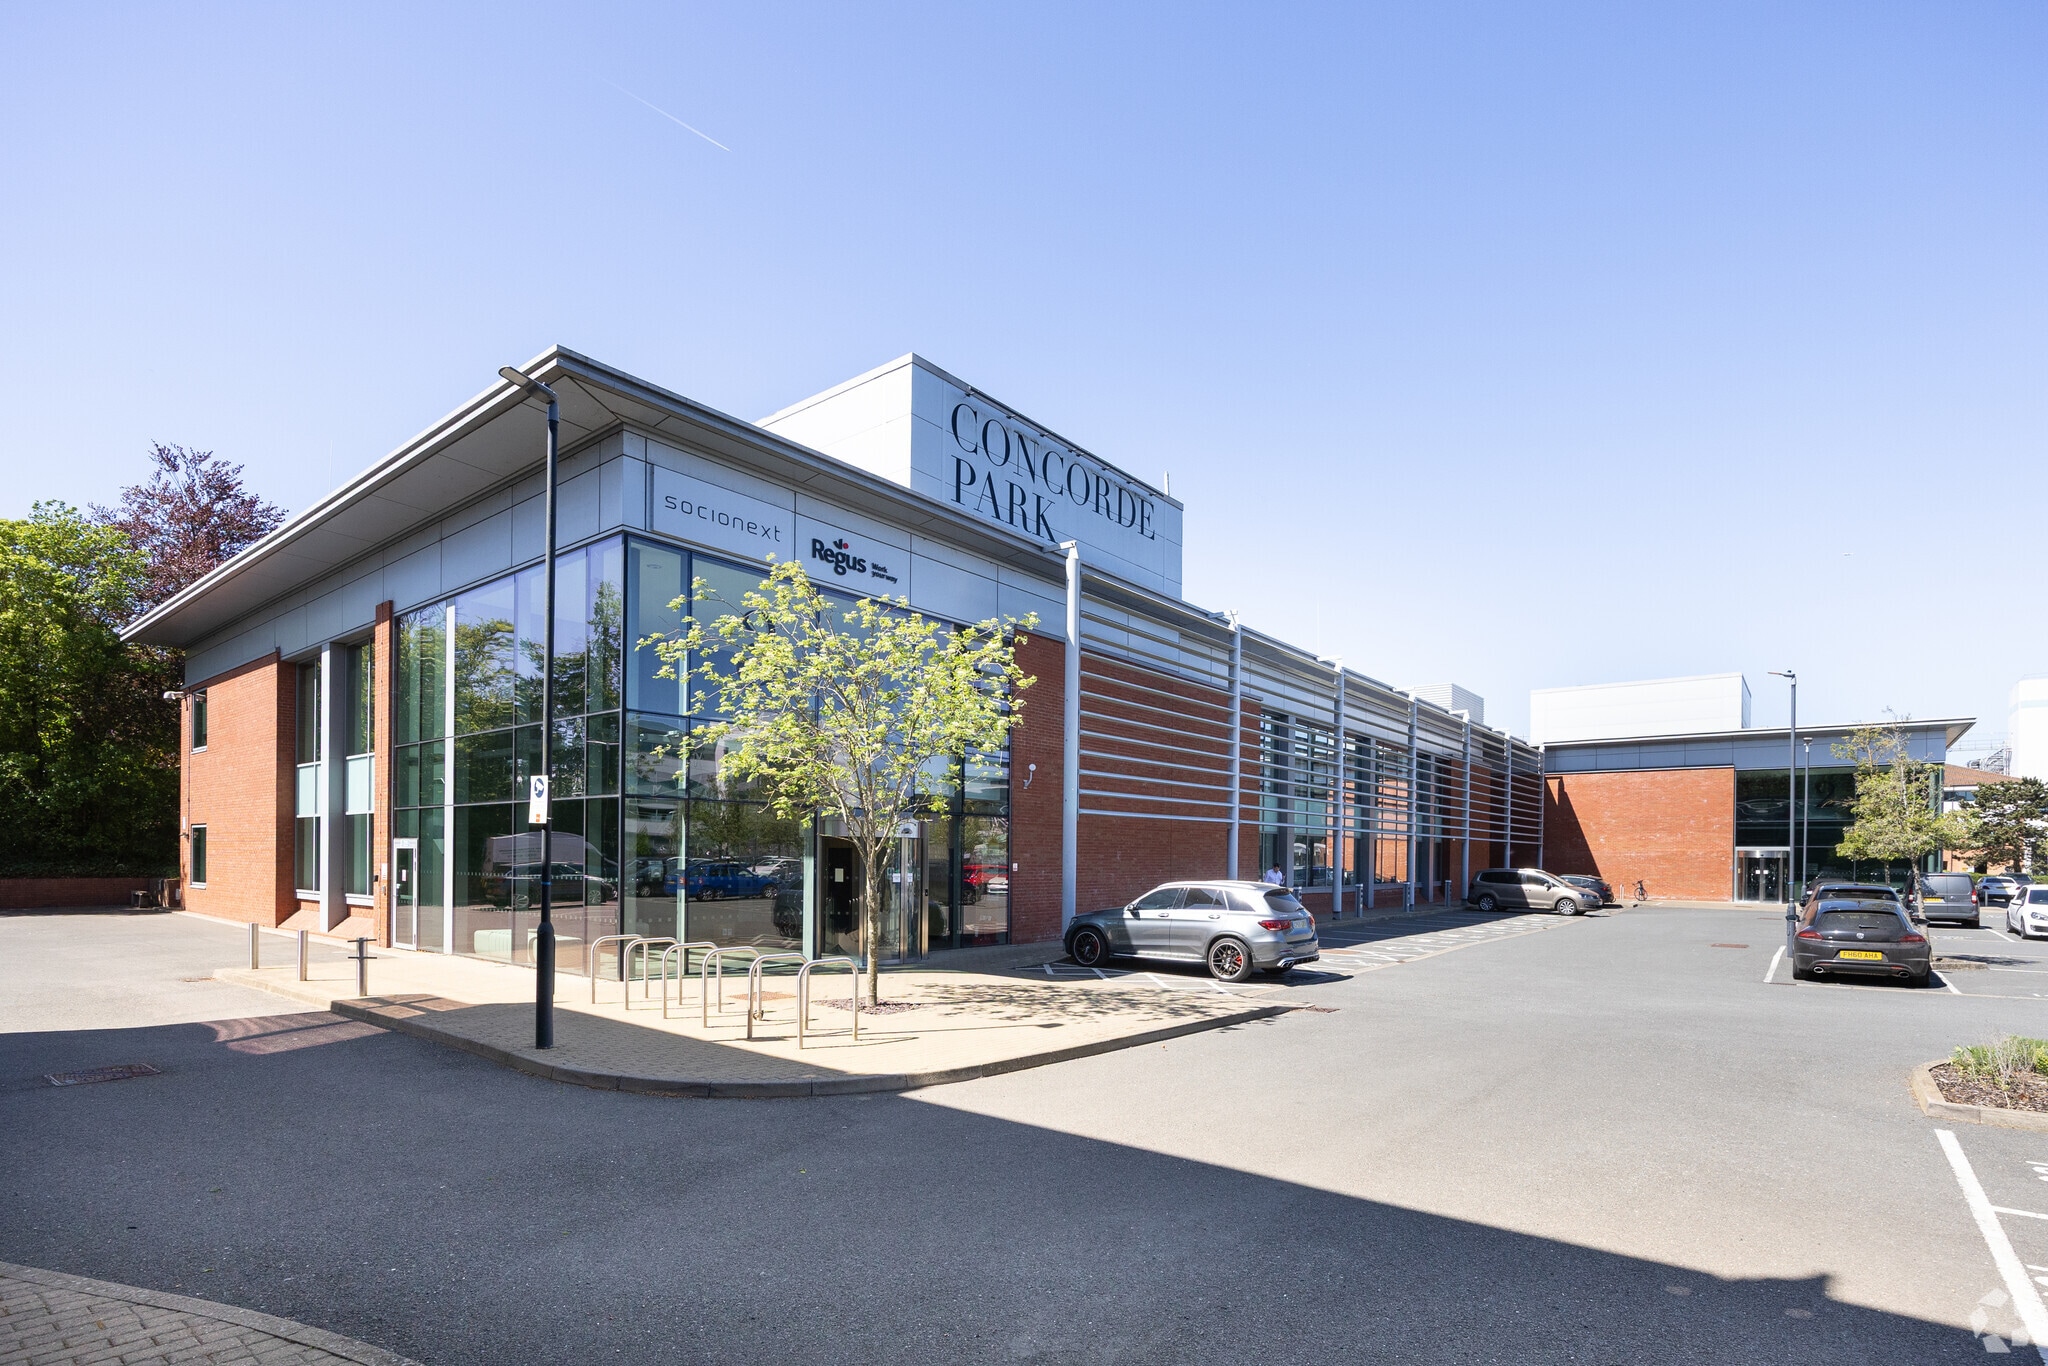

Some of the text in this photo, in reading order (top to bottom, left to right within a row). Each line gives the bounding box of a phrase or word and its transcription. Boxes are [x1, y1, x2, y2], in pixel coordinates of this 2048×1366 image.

[951, 403, 1156, 541] CONCORDE
[664, 495, 782, 543] socionext
[951, 454, 1058, 544] PARK
[811, 538, 867, 576] Regus
[871, 562, 888, 573] Work
